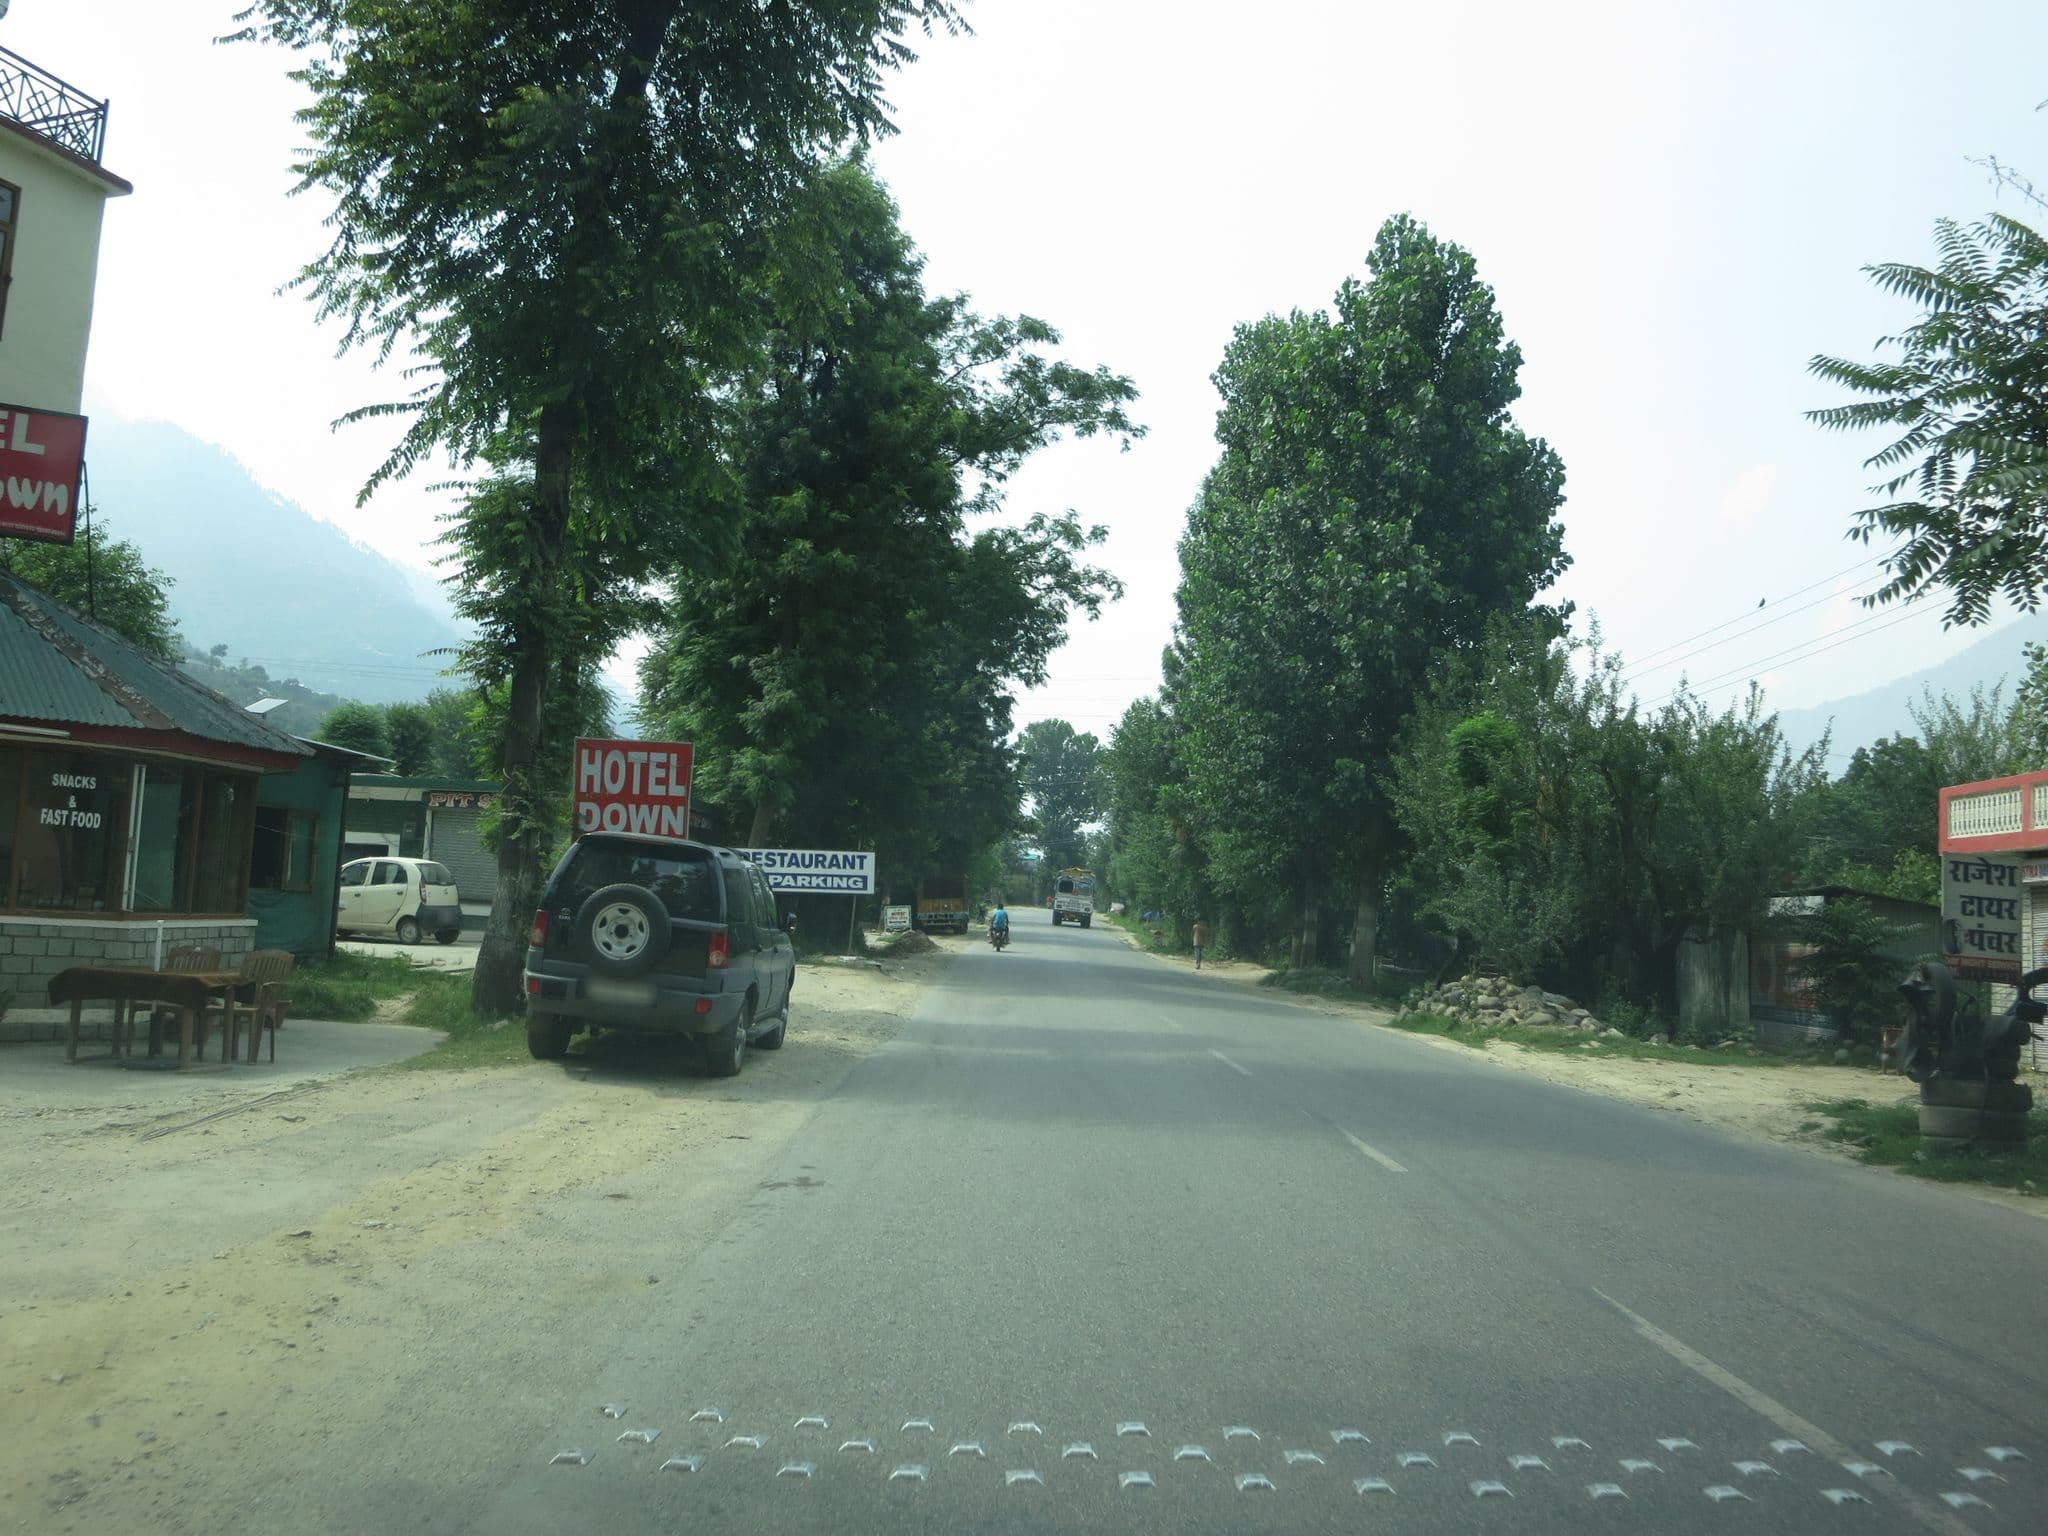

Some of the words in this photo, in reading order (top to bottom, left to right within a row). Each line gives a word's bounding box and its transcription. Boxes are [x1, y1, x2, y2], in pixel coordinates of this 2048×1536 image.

[52, 773, 97, 790] SNACKS
[580, 749, 687, 797] HOTEL
[68, 795, 77, 808] &
[429, 792, 474, 808] PIT
[40, 808, 69, 826] FAST
[71, 810, 101, 829] FOOD
[578, 801, 685, 835] DOWN
[768, 875, 864, 889] PARKING
[1949, 857, 2018, 887] राजेश
[1959, 895, 2018, 920] टायर
[1967, 923, 2018, 953] पंचर
